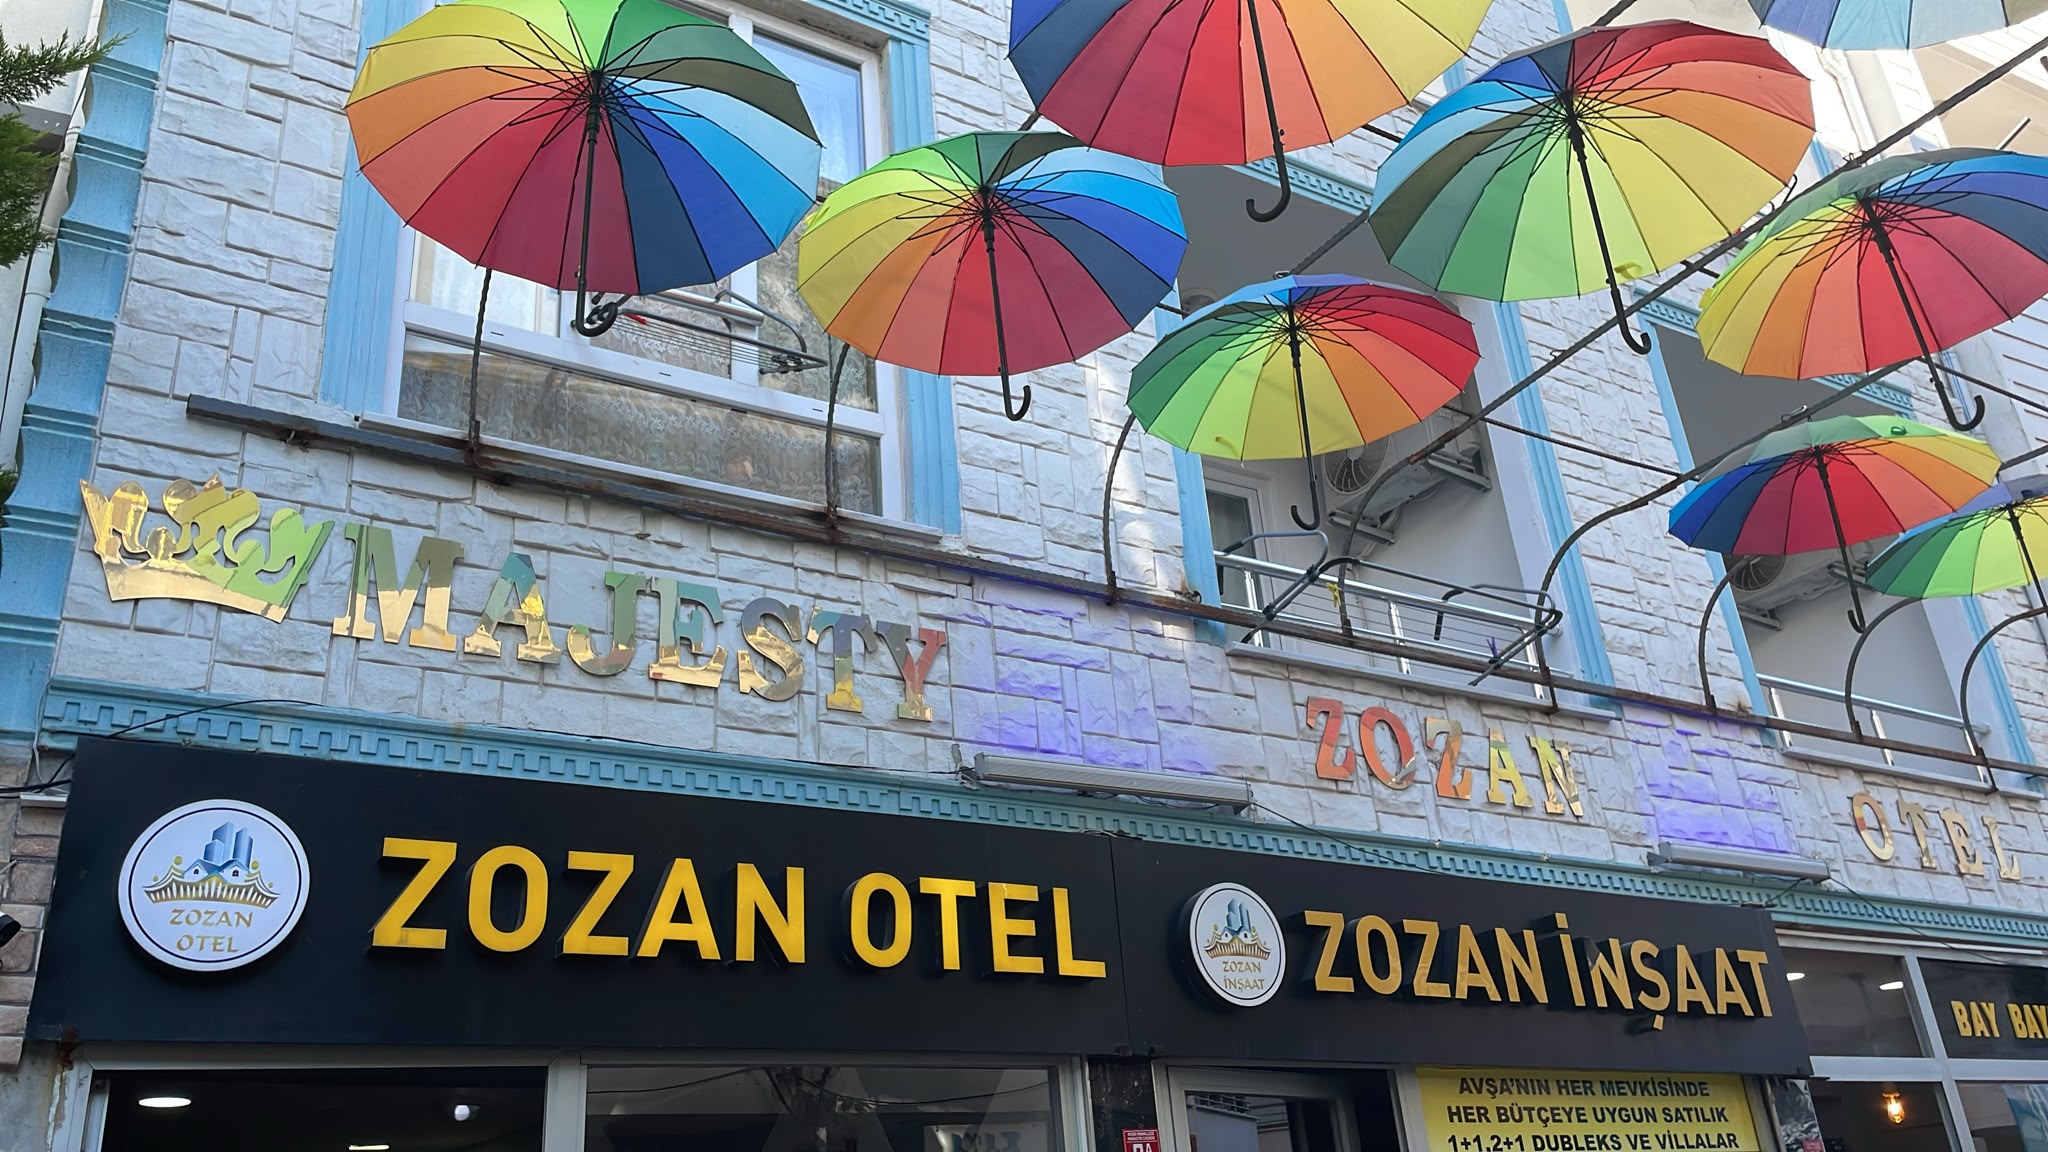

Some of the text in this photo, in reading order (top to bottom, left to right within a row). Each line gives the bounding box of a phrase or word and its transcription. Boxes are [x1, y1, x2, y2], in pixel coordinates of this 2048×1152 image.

[331, 522, 948, 722] MAJESTY
[1306, 696, 1587, 819] ZOZAN
[1851, 791, 2024, 883] OTEL
[169, 908, 254, 928] ZOZAN
[371, 836, 1107, 979] ZOZAN OTEL
[176, 934, 240, 953] OTEL
[1304, 909, 1549, 1005] ZOZAN
[1222, 960, 1262, 973] ZOZAN
[1951, 1000, 2048, 1039] BAY BAY
[1555, 1079, 1596, 1096] HER
[1600, 1077, 1710, 1097] MEVKİSİNDE
[1447, 1102, 1729, 1128] HER BÜTÇEYE UYGUN SATILIK
[1531, 1134, 1622, 1151] DUBLEKS
[1626, 1134, 1652, 1151] VE
[1655, 1129, 1740, 1149] VİLLALAR
